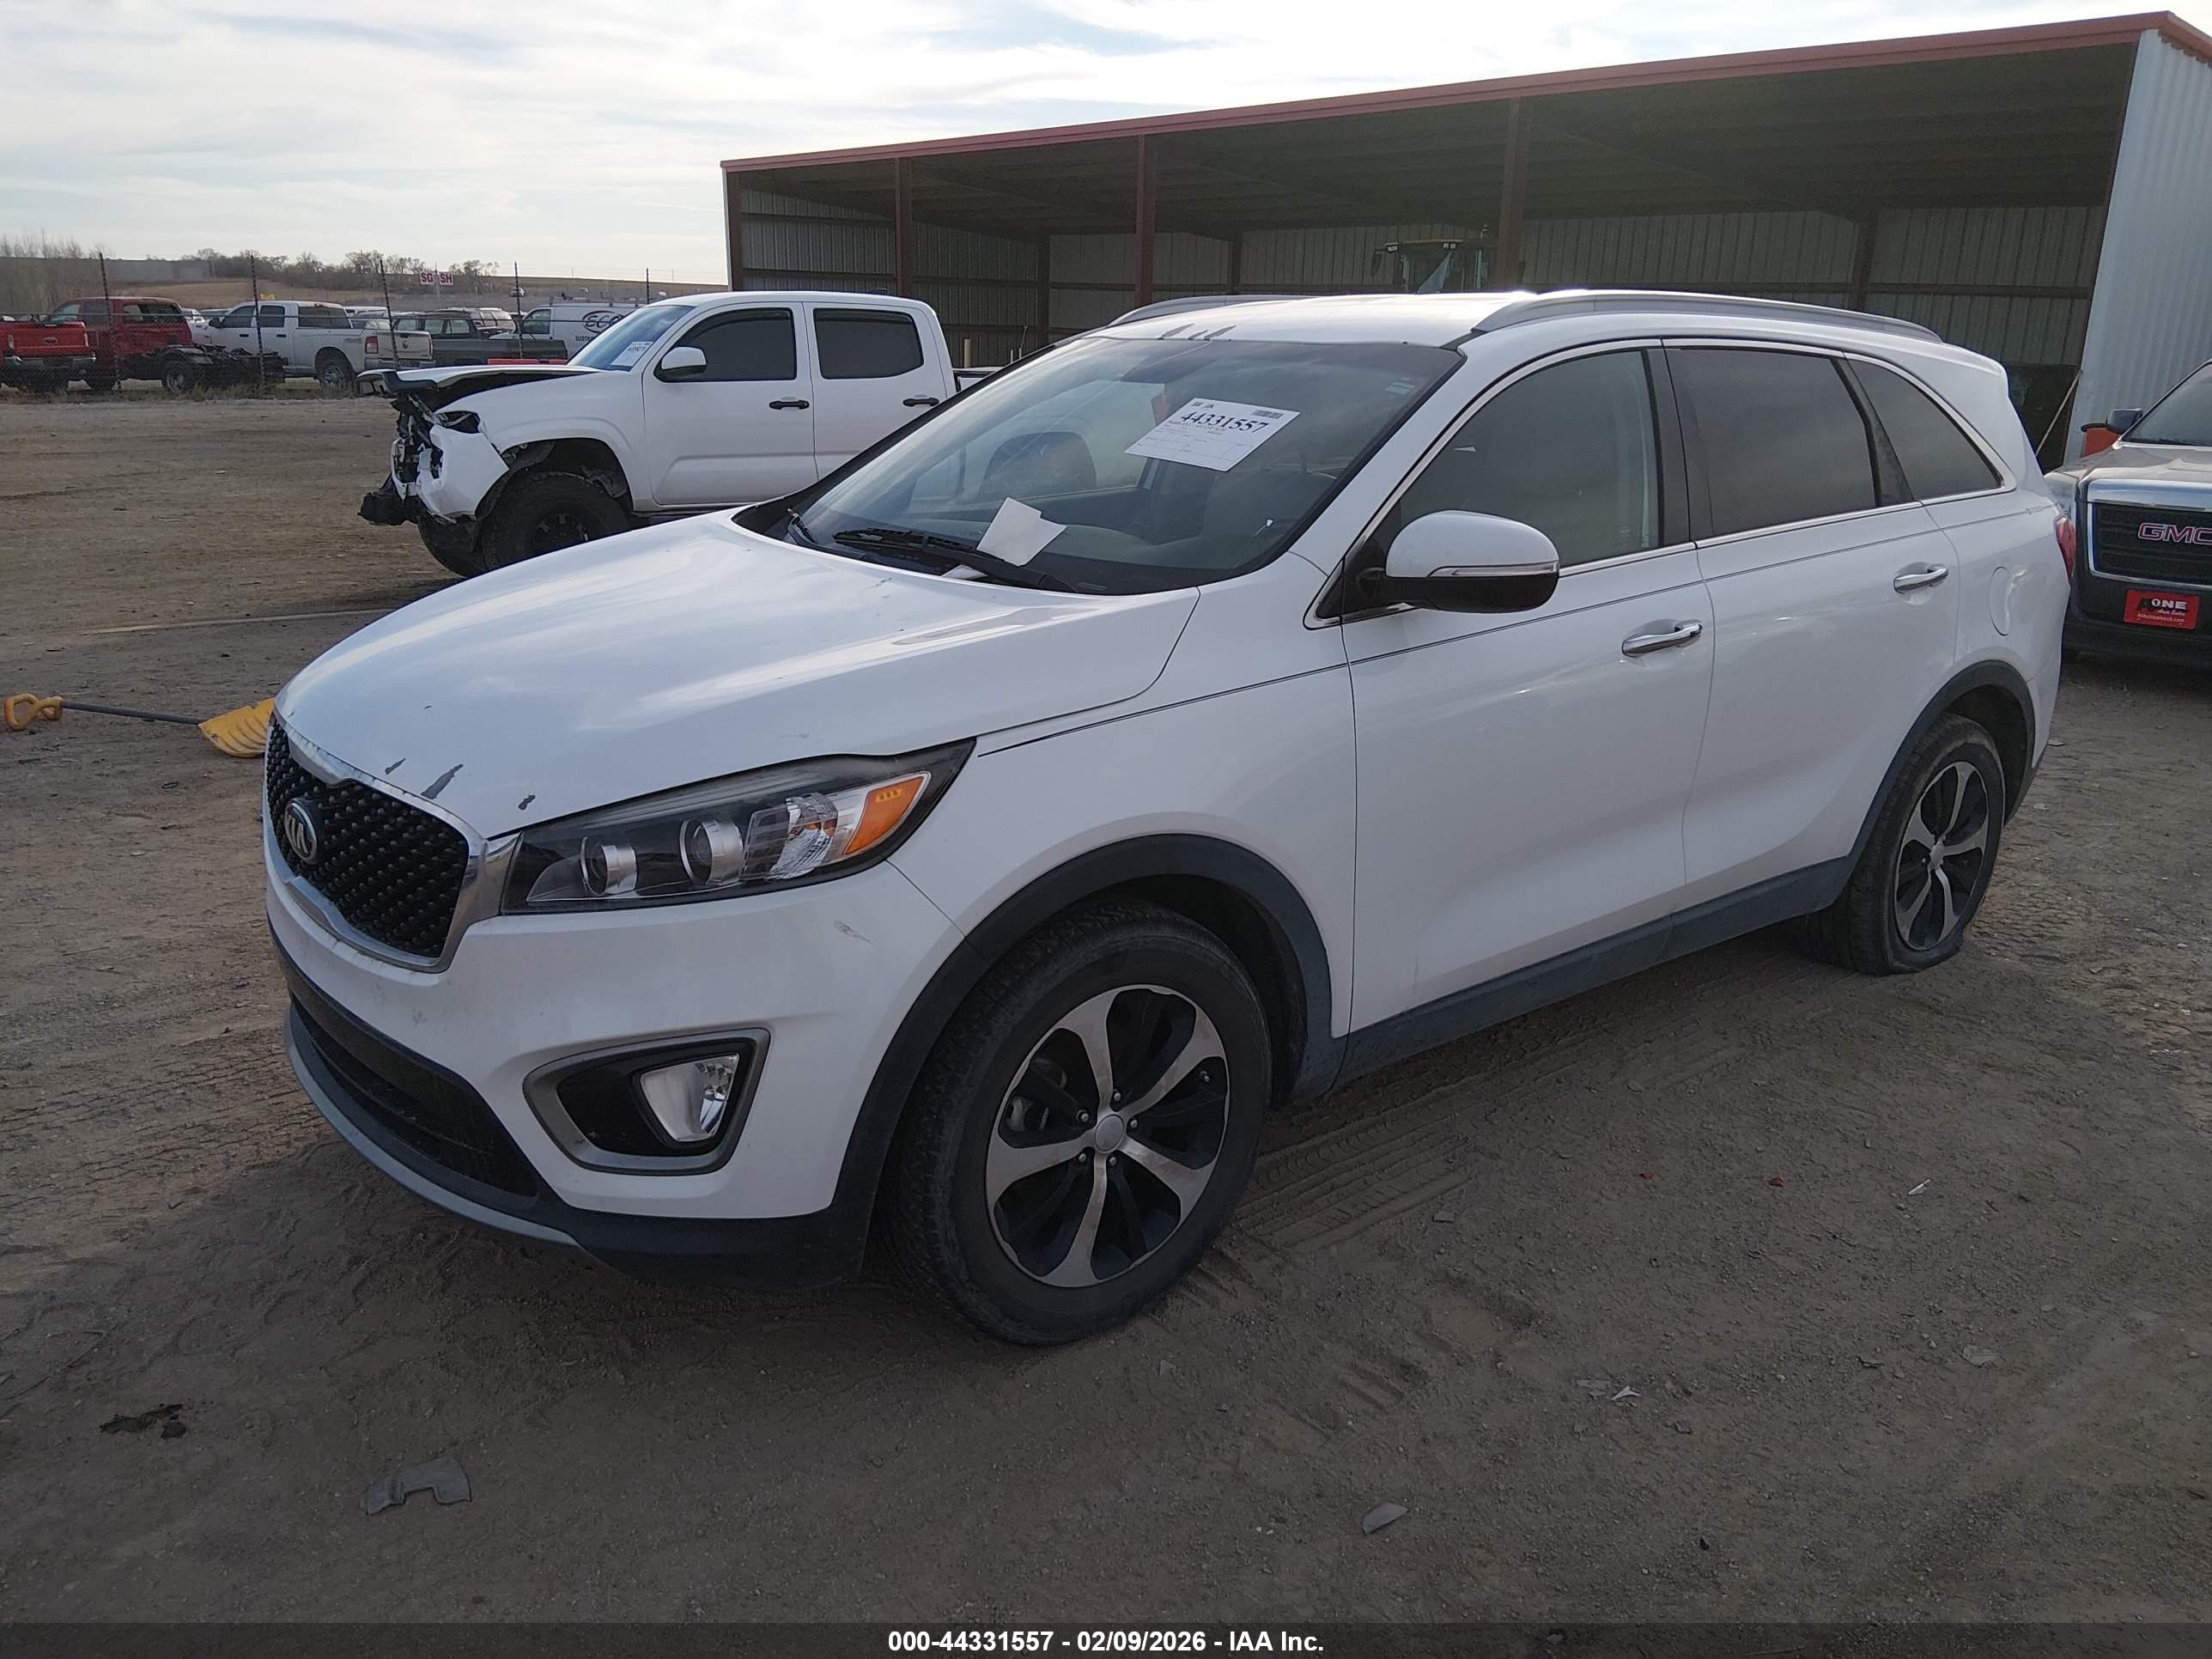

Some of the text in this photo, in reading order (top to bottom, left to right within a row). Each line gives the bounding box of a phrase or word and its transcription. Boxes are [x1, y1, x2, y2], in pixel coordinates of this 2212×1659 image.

[440, 273, 453, 283] SH
[1181, 411, 1270, 434] 44331557
[2138, 522, 2212, 545] GMC
